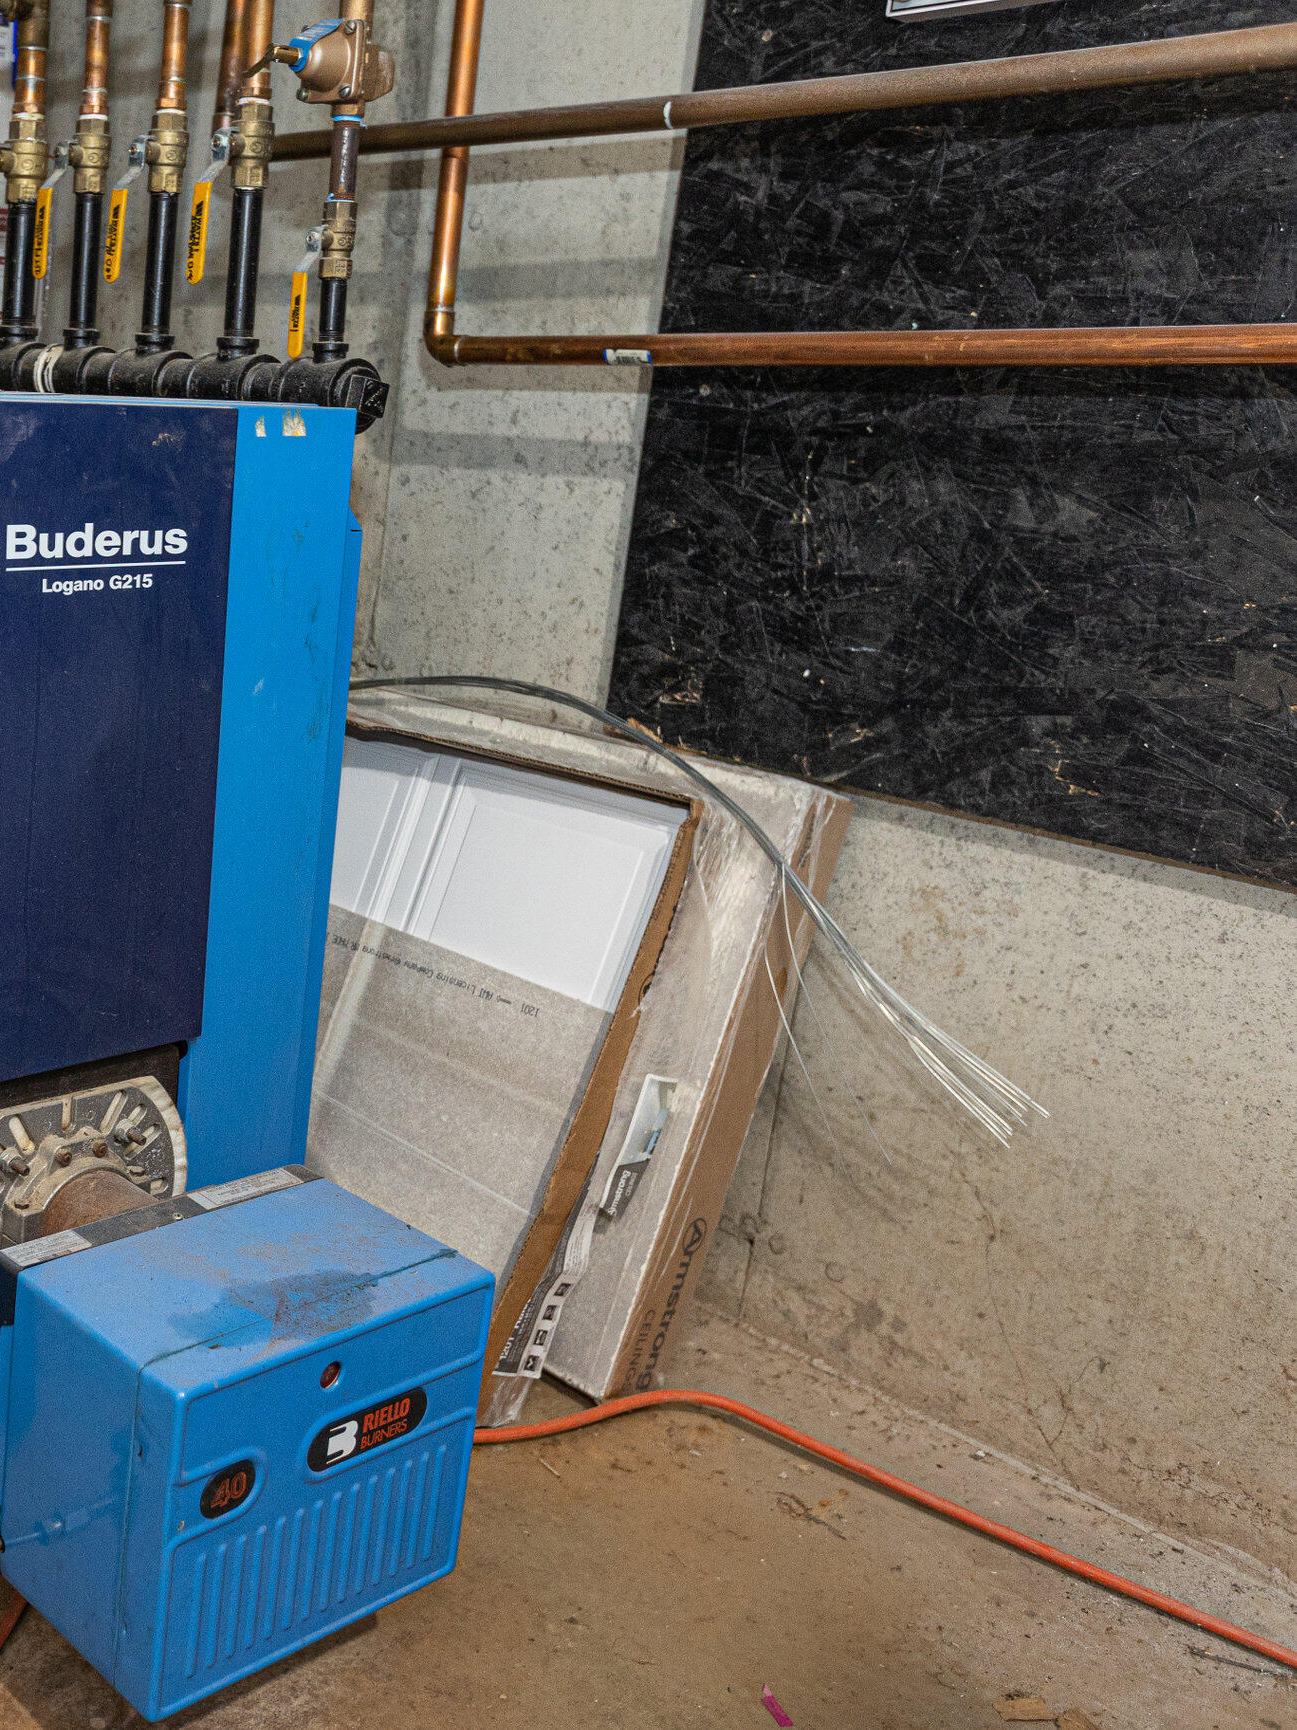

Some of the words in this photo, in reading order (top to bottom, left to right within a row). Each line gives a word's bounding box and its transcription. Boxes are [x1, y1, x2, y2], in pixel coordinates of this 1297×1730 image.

[5, 522, 188, 560] Buderus
[42, 578, 105, 596] Logano
[109, 574, 153, 590] G215
[362, 1398, 411, 1434] RIELLO
[360, 1419, 408, 1450] BURNERS
[210, 1471, 248, 1509] 40
